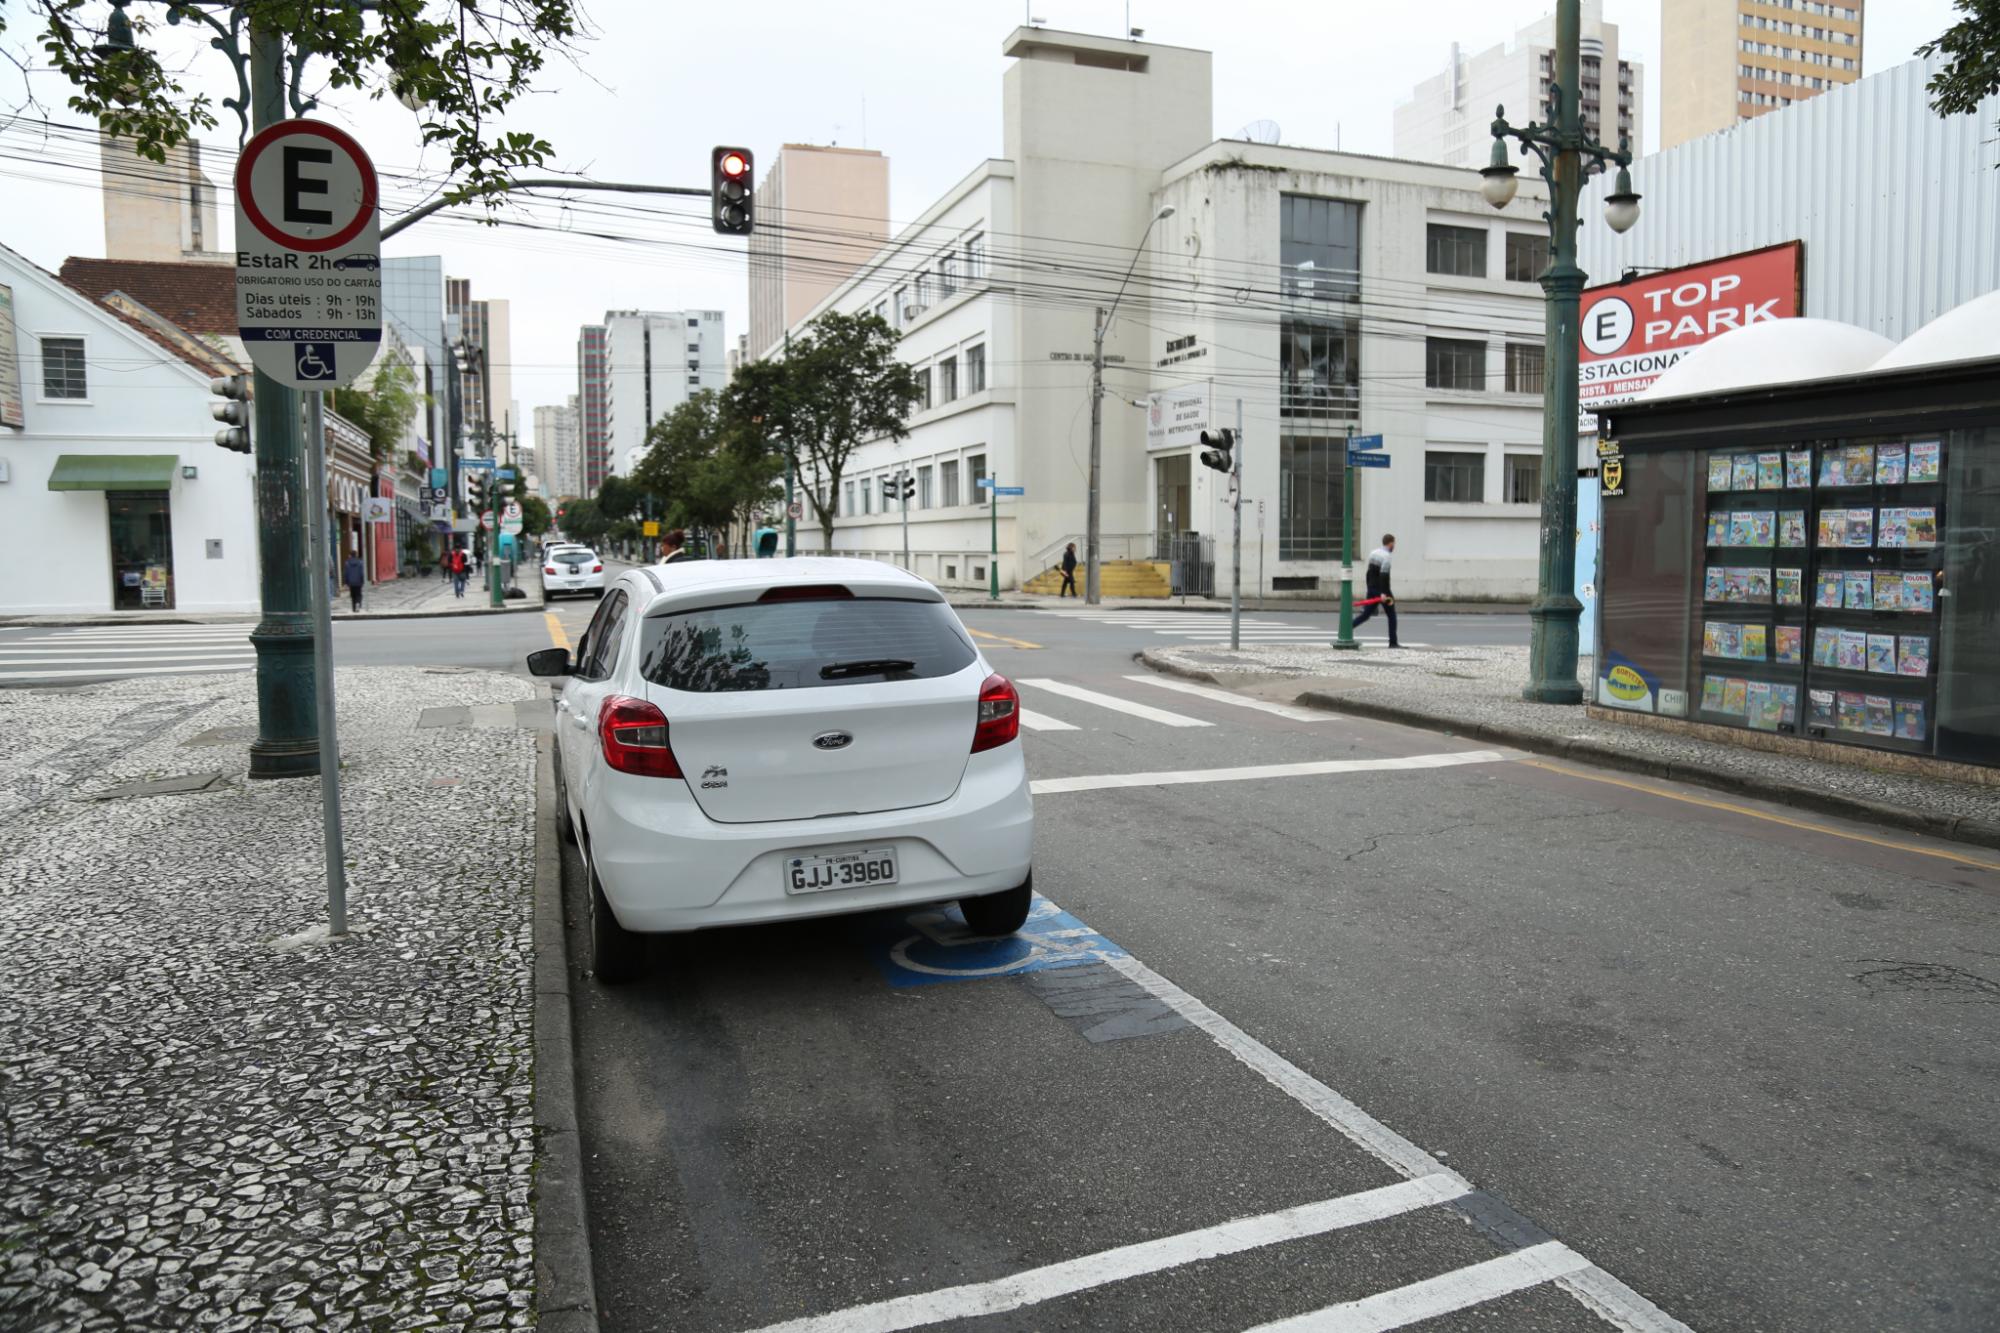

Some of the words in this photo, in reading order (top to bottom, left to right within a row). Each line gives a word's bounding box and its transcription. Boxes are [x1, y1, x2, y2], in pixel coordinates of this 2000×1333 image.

[283, 145, 333, 225] E
[236, 252, 299, 269] EstaR
[308, 255, 331, 270] 2h
[304, 277, 324, 287] USO
[327, 278, 342, 287] DO
[245, 292, 274, 305] Dias
[326, 295, 342, 306] 9h
[355, 295, 376, 307] 19h
[1644, 274, 1741, 313] TOP
[326, 310, 343, 320] 9h
[356, 309, 376, 321] 13h
[1644, 298, 1781, 345] PARK
[1596, 311, 1617, 342] E
[264, 329, 291, 340] COM
[294, 330, 361, 341] CREDENCIAL
[821, 735, 845, 746] Ford
